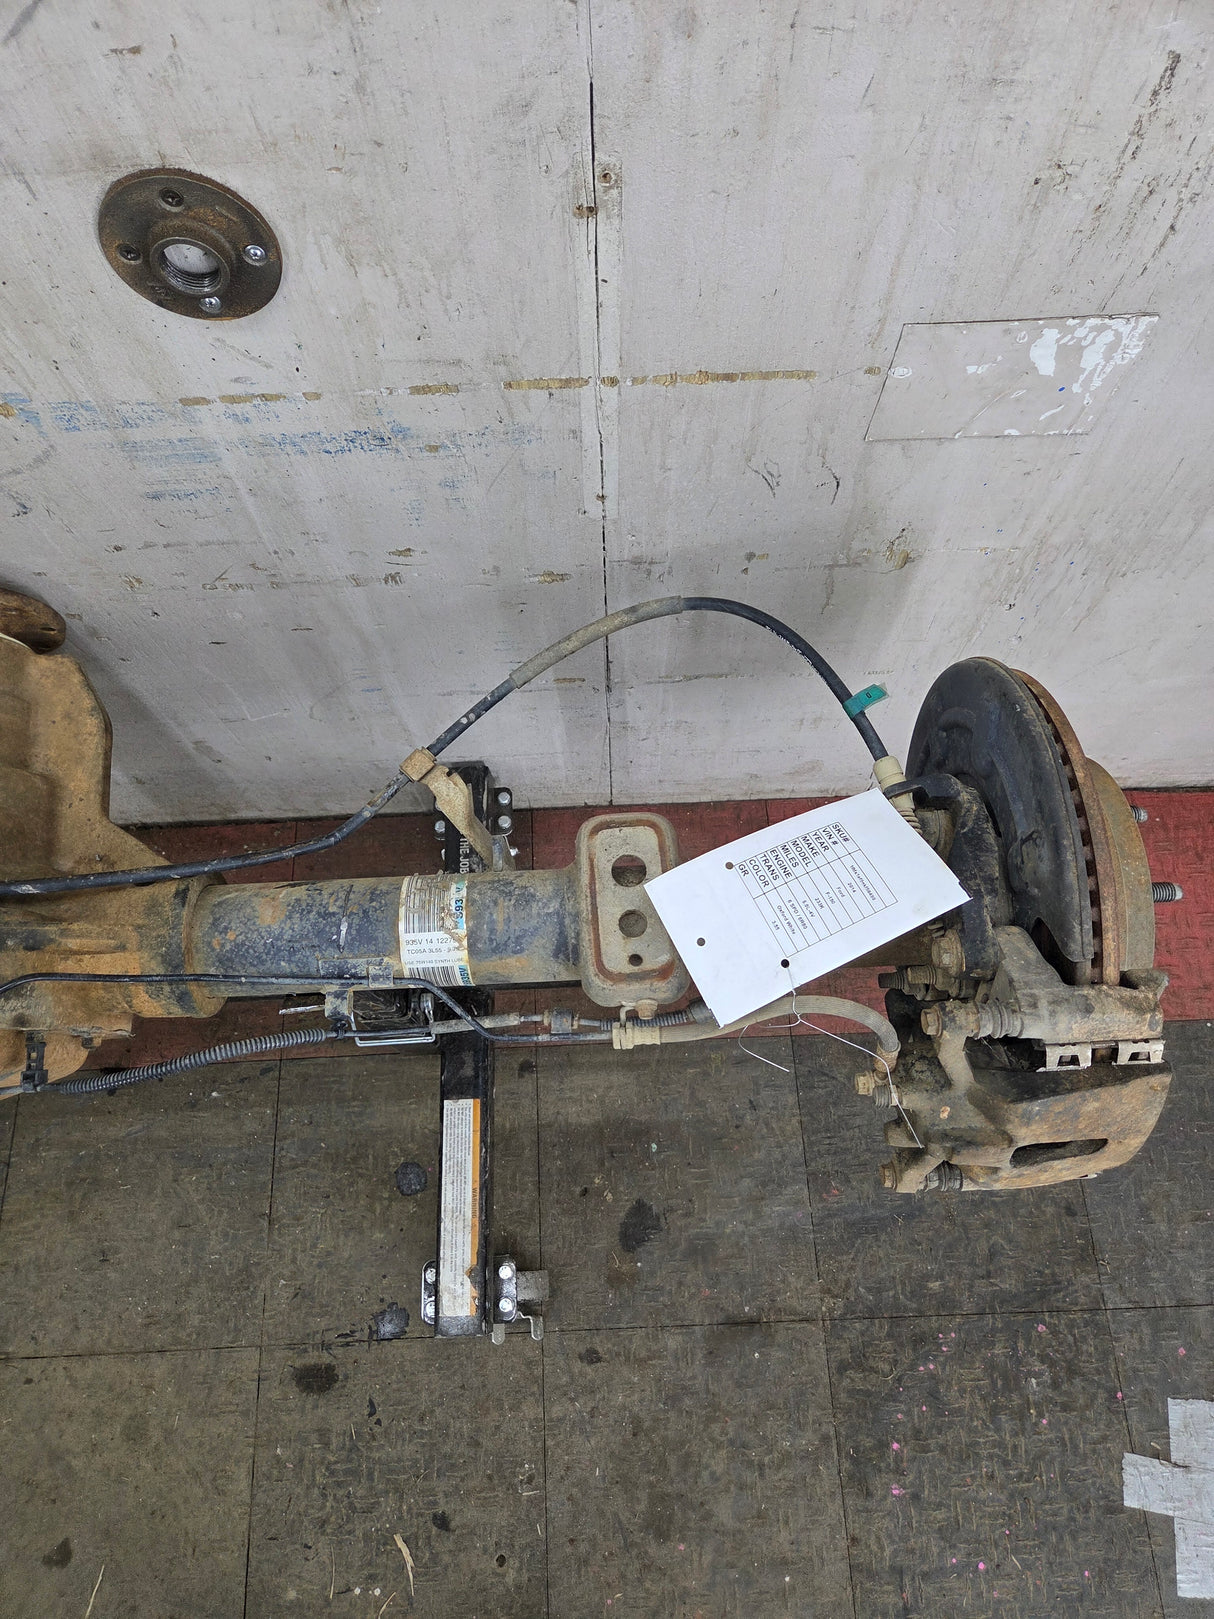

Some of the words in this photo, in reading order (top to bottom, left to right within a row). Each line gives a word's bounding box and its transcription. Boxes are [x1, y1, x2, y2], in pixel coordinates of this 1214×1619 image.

[812, 831, 830, 852] YEAR
[822, 827, 835, 840] VIN
[832, 824, 850, 842] SKU#
[460, 838, 469, 854] THE
[780, 844, 799, 868] MILES
[790, 840, 812, 868] MODEL
[801, 836, 820, 858] MAKE
[460, 856, 470, 874] JOB
[738, 864, 750, 877] GR
[749, 859, 770, 888] COLOR
[760, 854, 780, 881] TRANS
[770, 849, 793, 879] ENGINE
